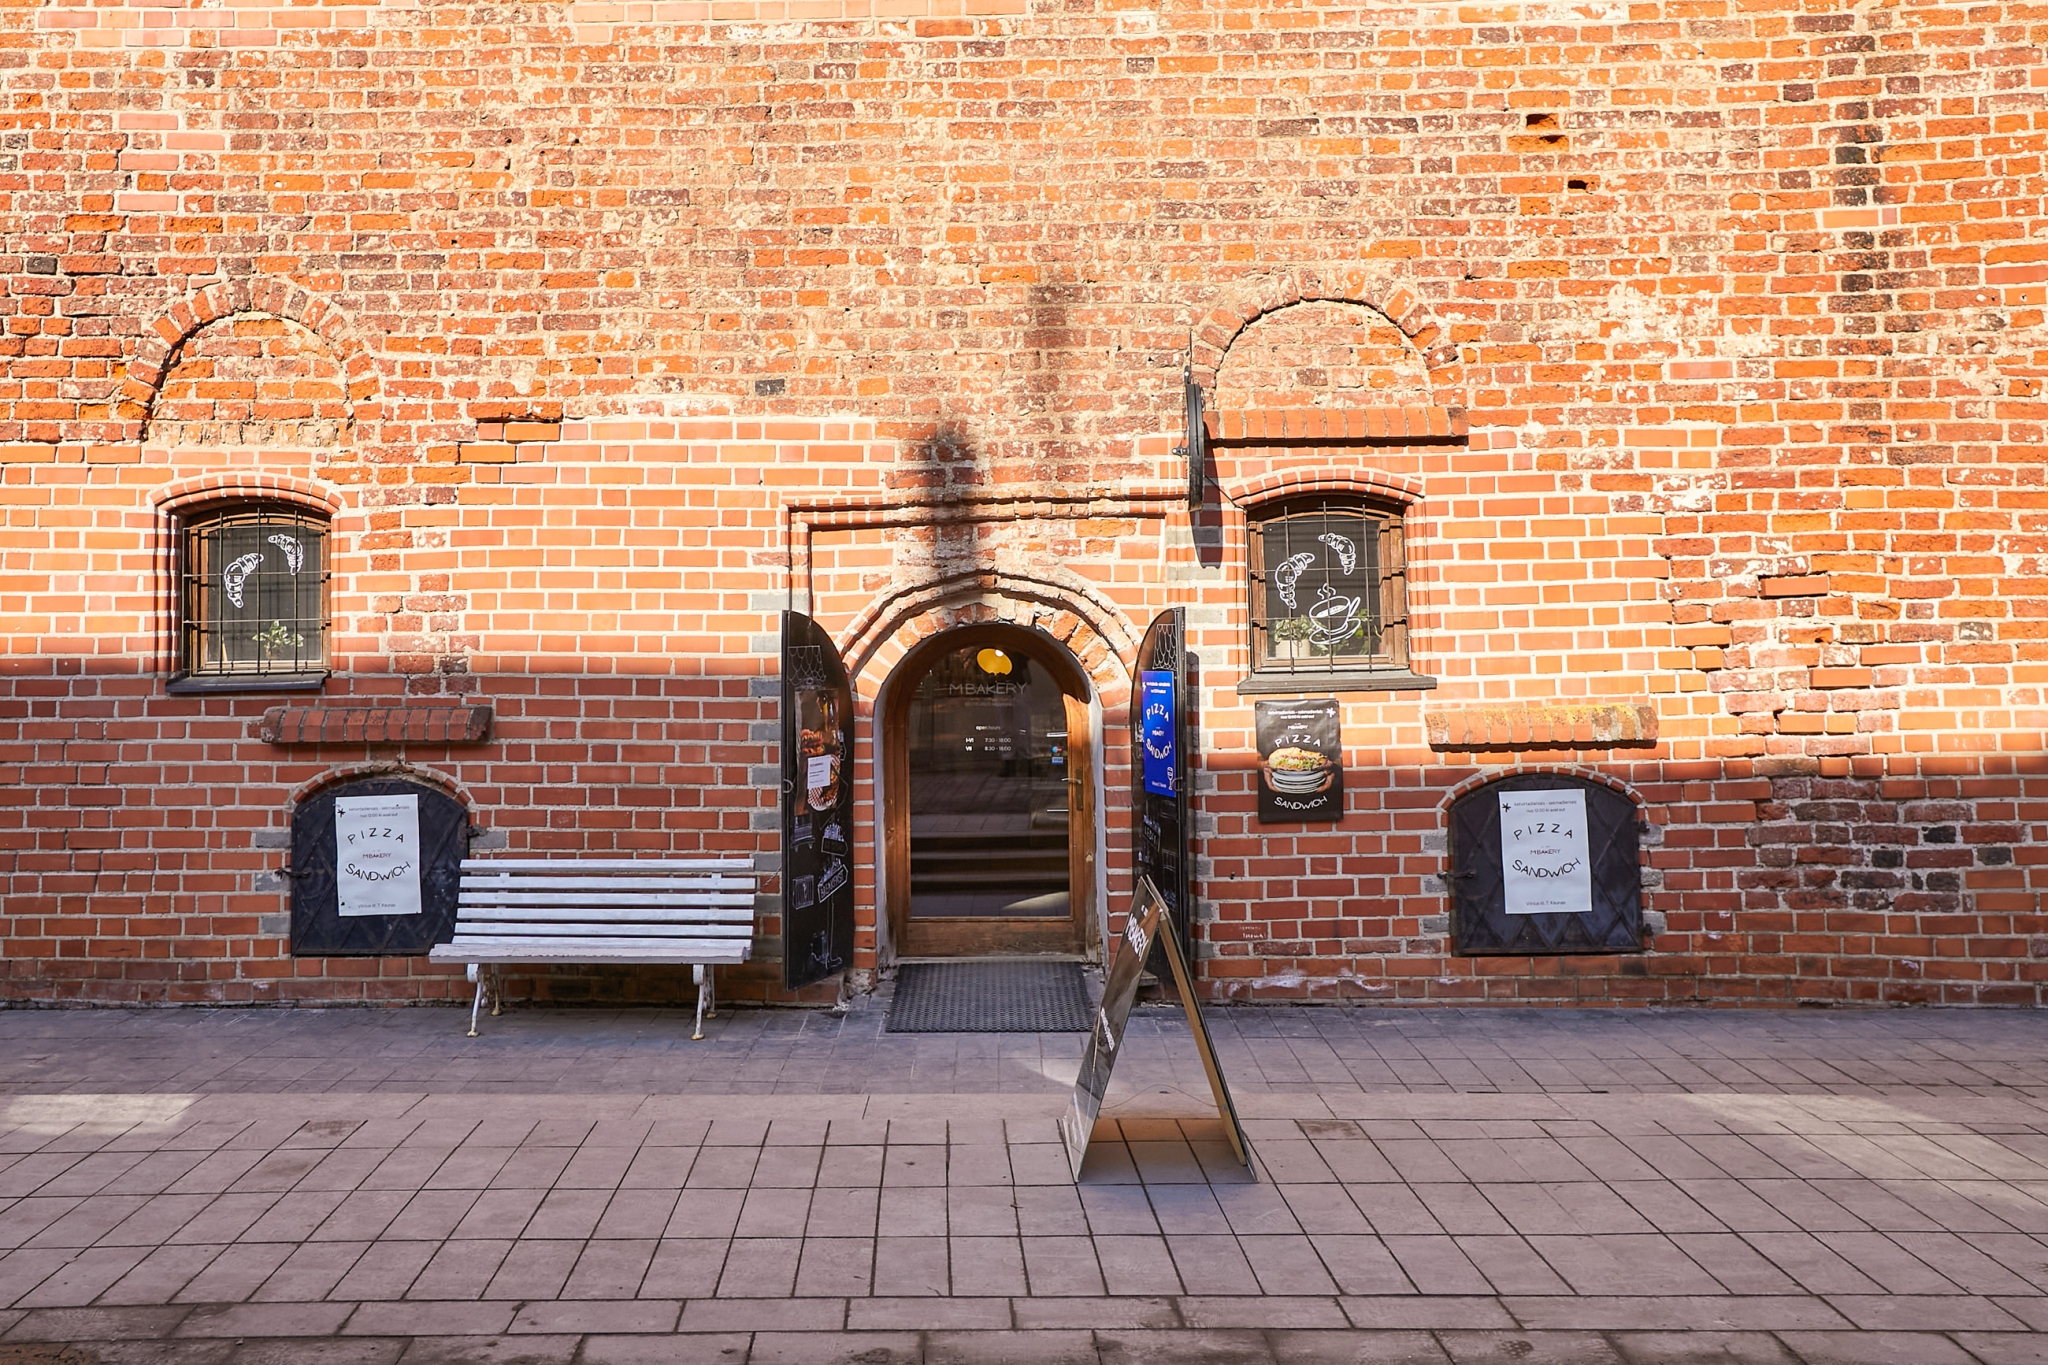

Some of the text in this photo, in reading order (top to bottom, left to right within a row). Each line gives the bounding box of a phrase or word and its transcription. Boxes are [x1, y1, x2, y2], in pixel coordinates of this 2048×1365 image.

[1145, 702, 1170, 722] PIZZA
[1145, 738, 1172, 760] SANDWICH
[1274, 733, 1321, 748] PIZZA
[1273, 795, 1328, 810] SANDWICH
[347, 827, 404, 845] PIZZA
[1513, 822, 1573, 841] PIZZA
[345, 861, 411, 881] SANDWICH
[1512, 857, 1581, 878] SANDWICH
